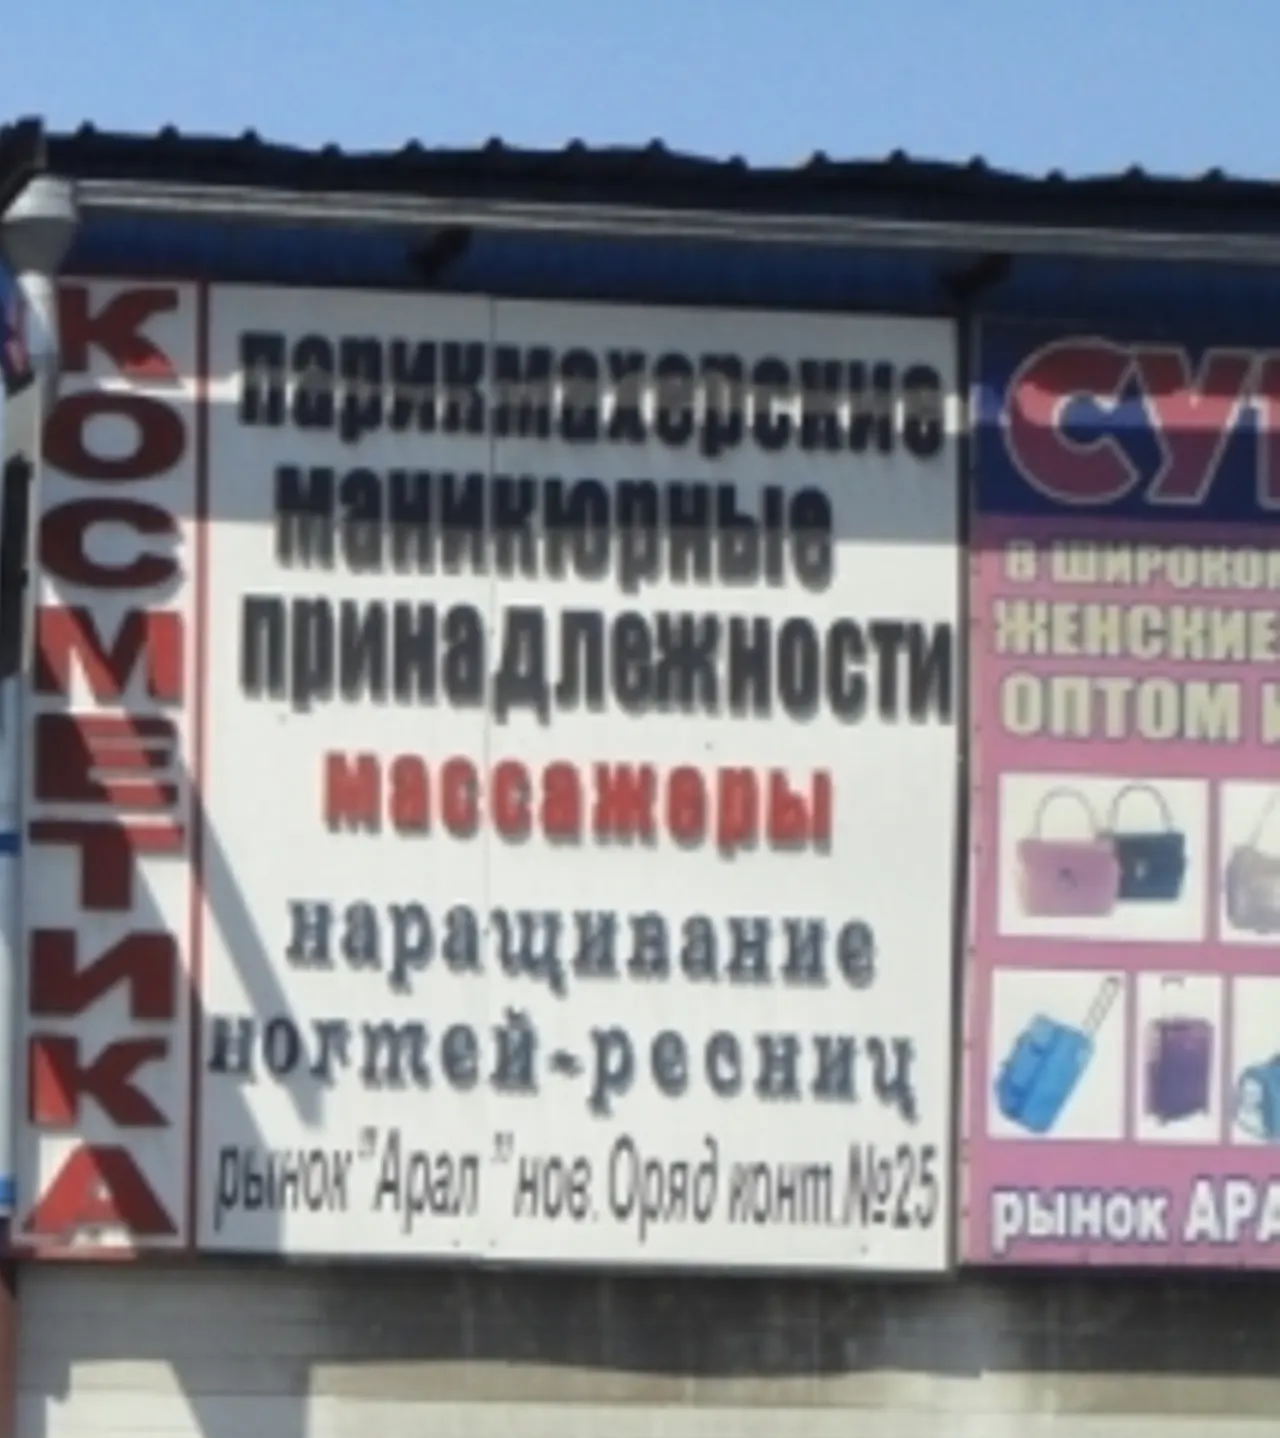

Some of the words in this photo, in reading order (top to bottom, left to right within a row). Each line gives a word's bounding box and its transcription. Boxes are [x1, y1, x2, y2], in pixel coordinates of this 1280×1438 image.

[1004, 338, 1280, 508] СУ
[273, 464, 836, 594] маникюрные
[1004, 540, 1039, 583] В
[238, 592, 956, 728] принадлежности
[992, 600, 1280, 664] ЖЕНСКИЕ
[1001, 672, 1243, 743] ОПТОМ
[22, 285, 186, 1240] КОСМЕТИКА
[286, 897, 877, 1000] наращивание
[214, 1143, 354, 1234] рынок
[991, 1187, 1167, 1251] рынок
